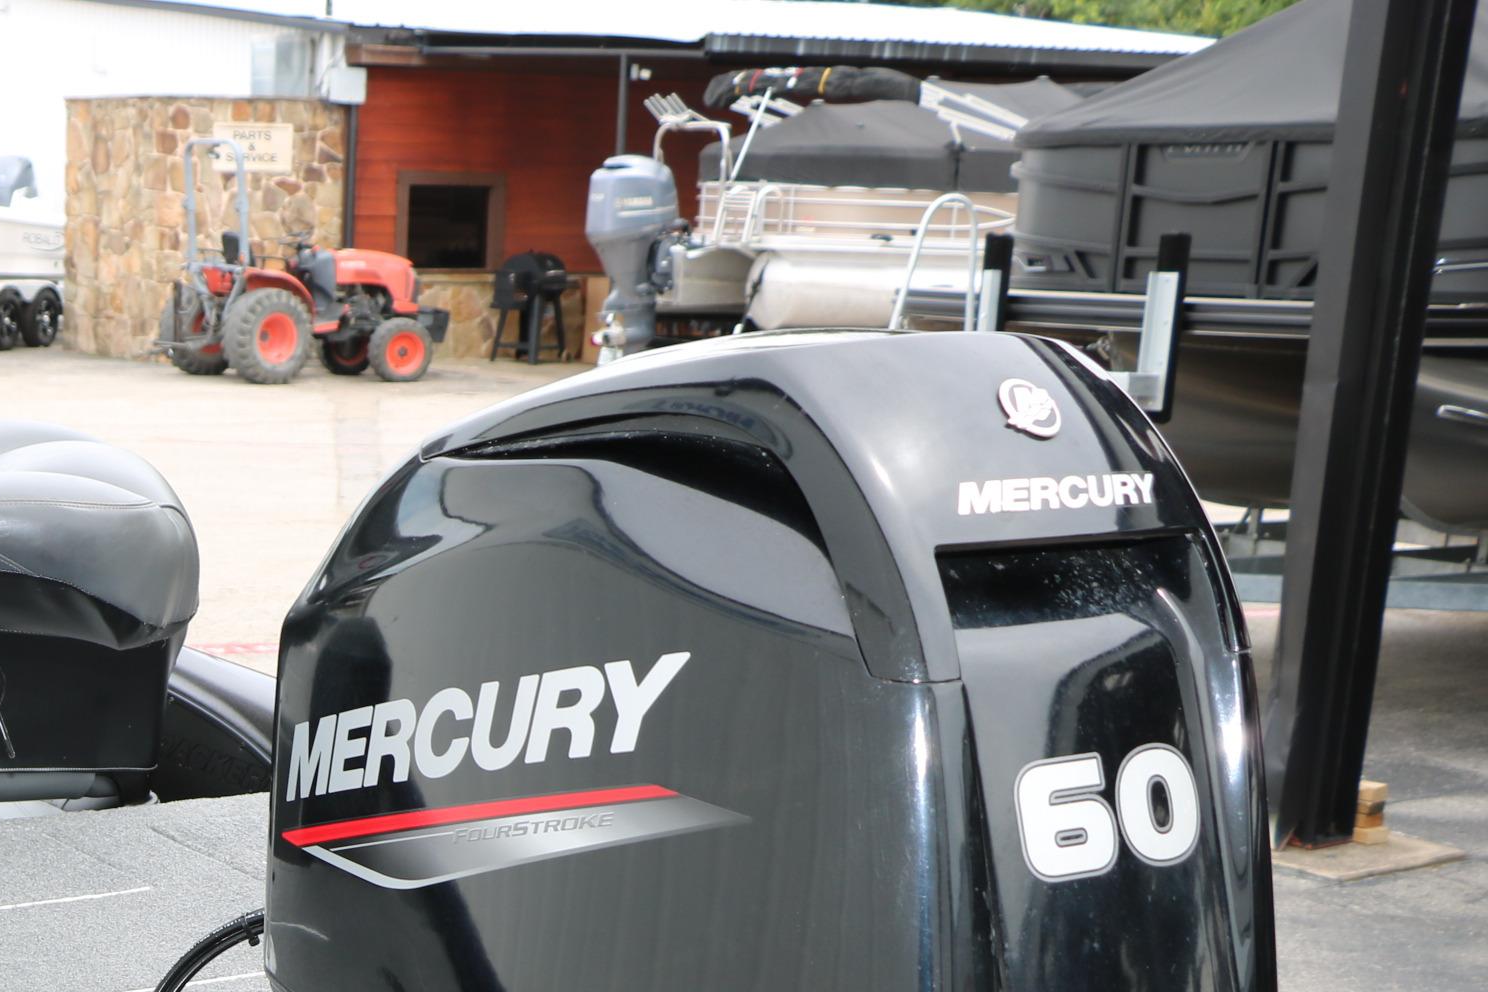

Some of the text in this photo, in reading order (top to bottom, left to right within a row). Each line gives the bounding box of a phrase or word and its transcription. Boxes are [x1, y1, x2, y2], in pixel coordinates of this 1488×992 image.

[232, 129, 273, 141] PARTS
[225, 151, 279, 163] SRVICE
[957, 473, 1154, 515] MERCURY
[285, 651, 691, 802] MERCURY
[1014, 742, 1201, 883] 60
